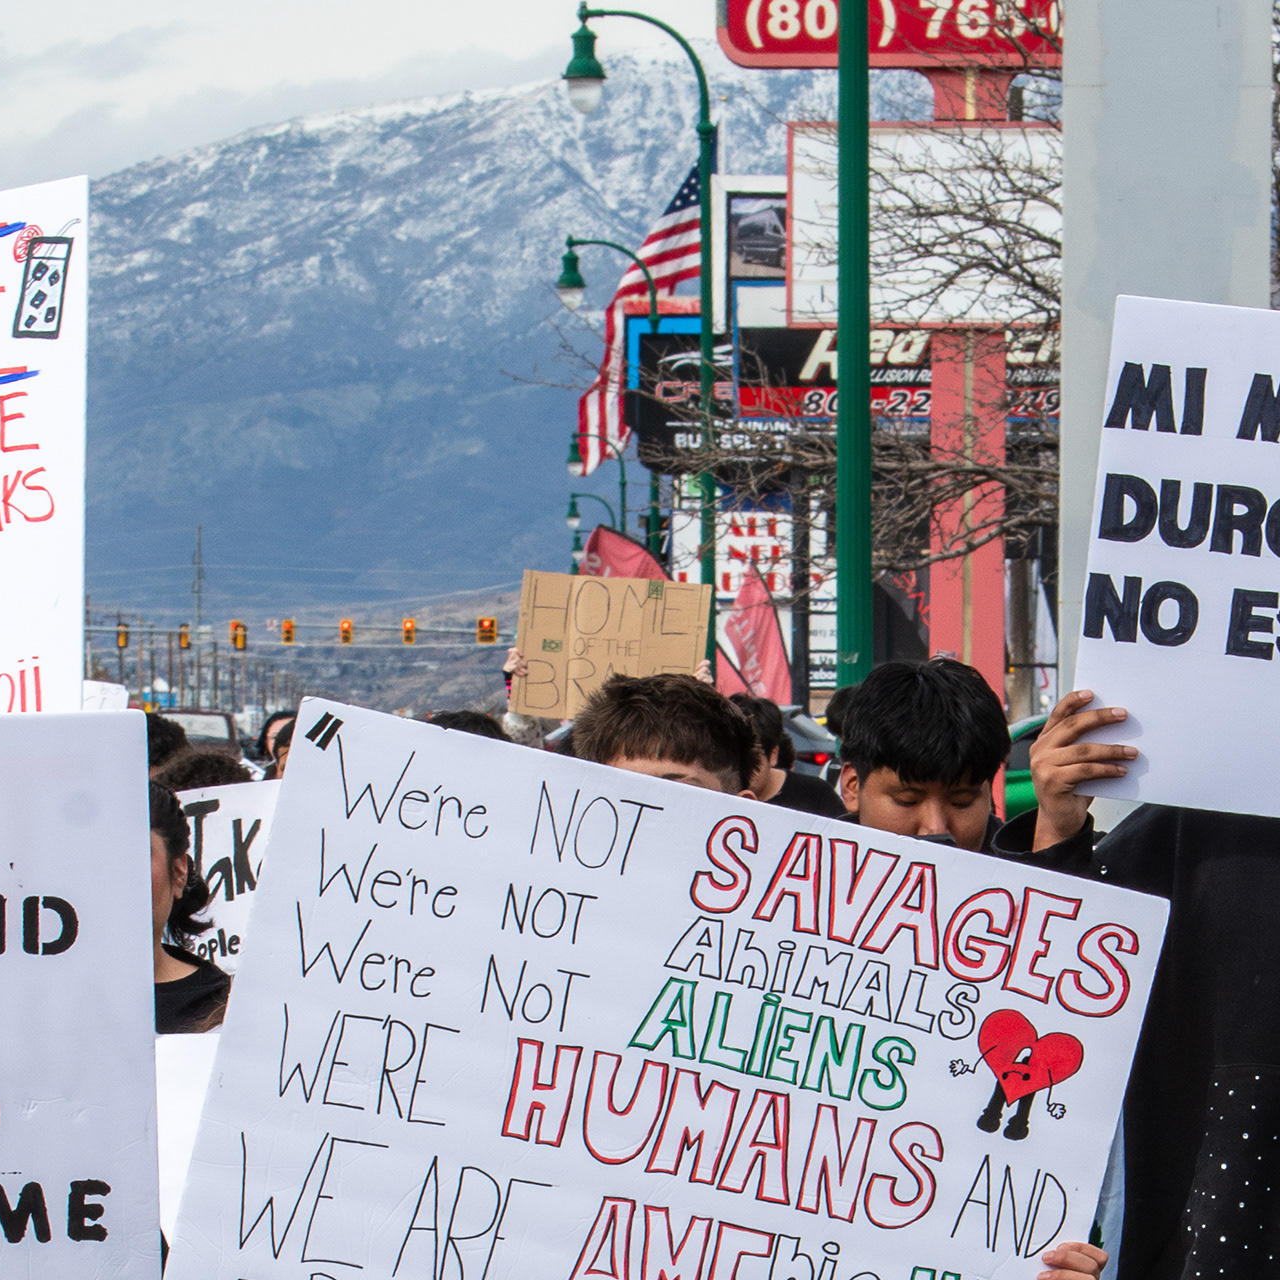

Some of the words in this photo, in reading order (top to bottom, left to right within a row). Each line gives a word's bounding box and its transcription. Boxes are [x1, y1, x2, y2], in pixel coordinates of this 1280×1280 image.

[745, 0, 896, 48] (80)
[1104, 362, 1208, 436] MI
[1082, 572, 1199, 646] NO
[319, 828, 458, 918] We're
[501, 882, 598, 944] NOT
[530, 780, 664, 876] NOT
[690, 815, 1140, 1017] SAVAGES
[296, 901, 436, 997] We're
[238, 1131, 389, 1269] WE
[501, 1037, 944, 1230] HUMANS
[951, 1154, 1069, 1259] AND
